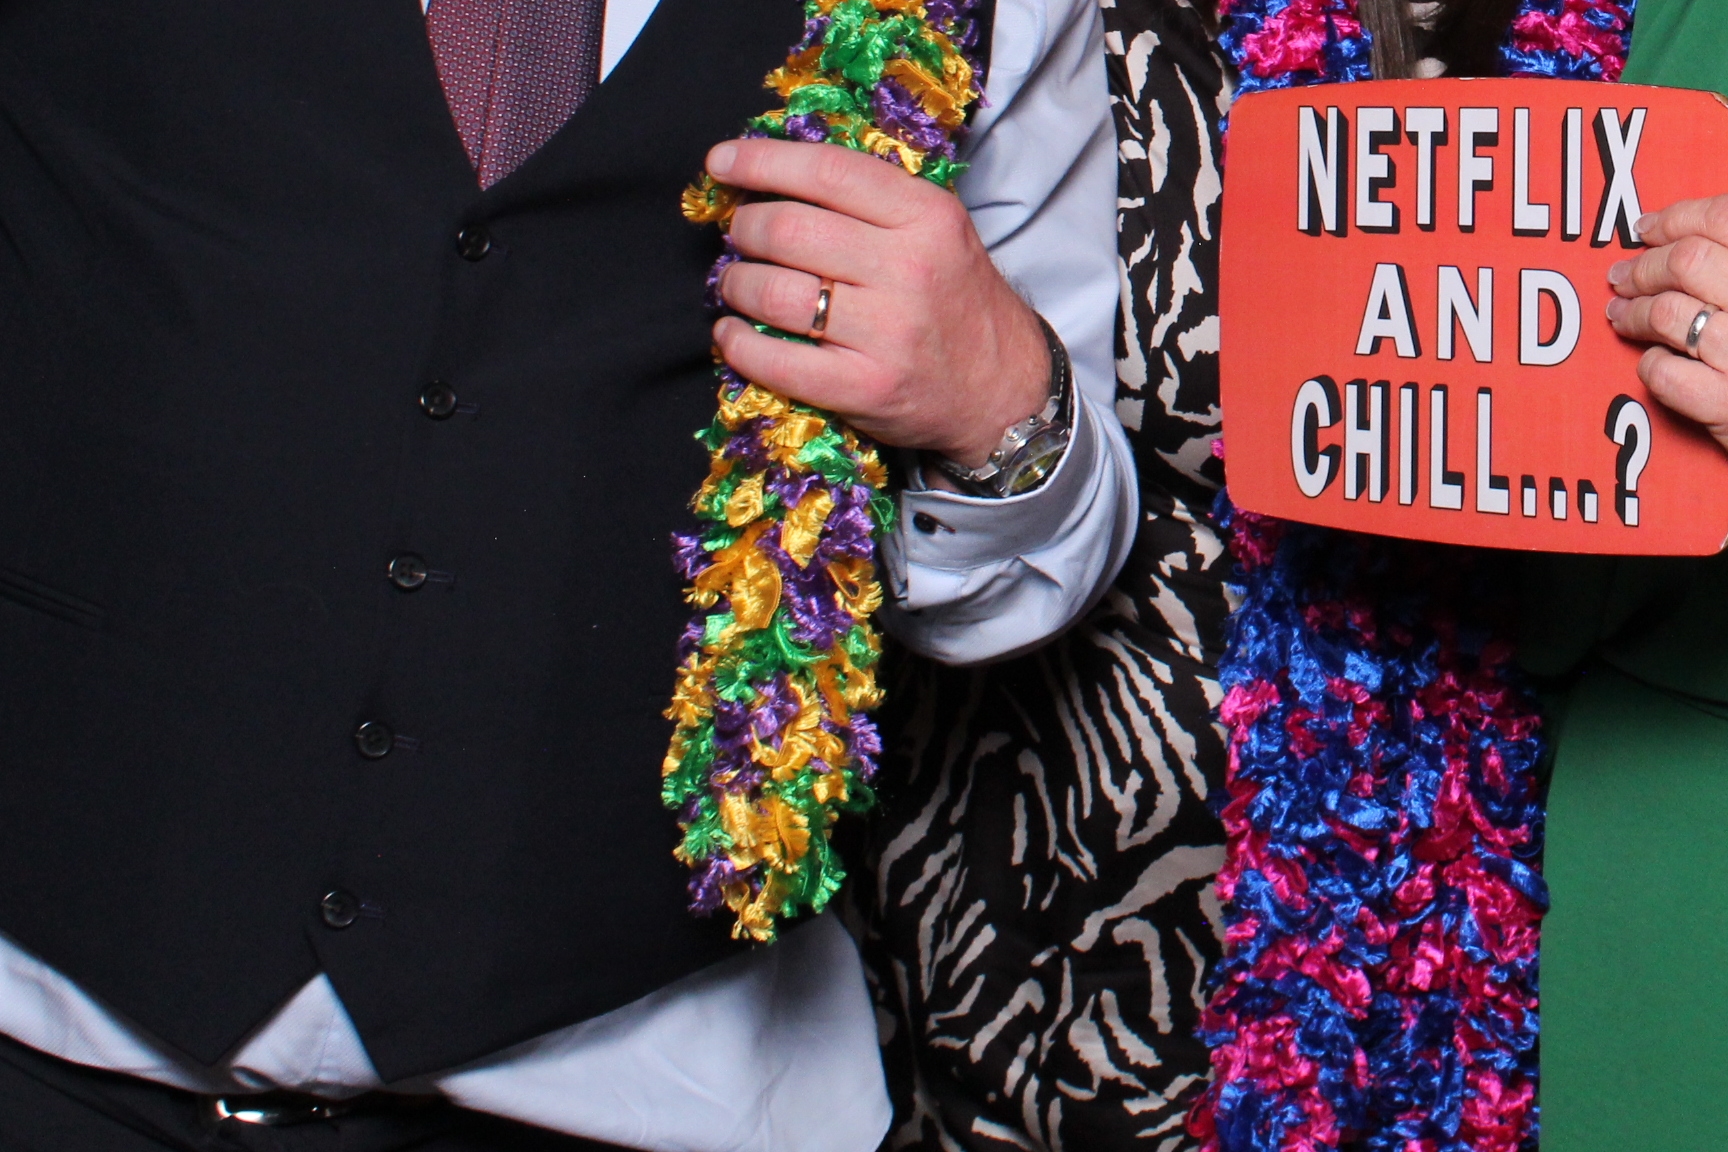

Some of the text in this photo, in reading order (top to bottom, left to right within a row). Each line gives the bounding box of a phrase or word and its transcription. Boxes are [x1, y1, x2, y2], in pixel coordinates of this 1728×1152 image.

[1297, 105, 1649, 248] NETFLIX
[1354, 262, 1582, 367] AND
[1290, 374, 1652, 528] CHILL...?
